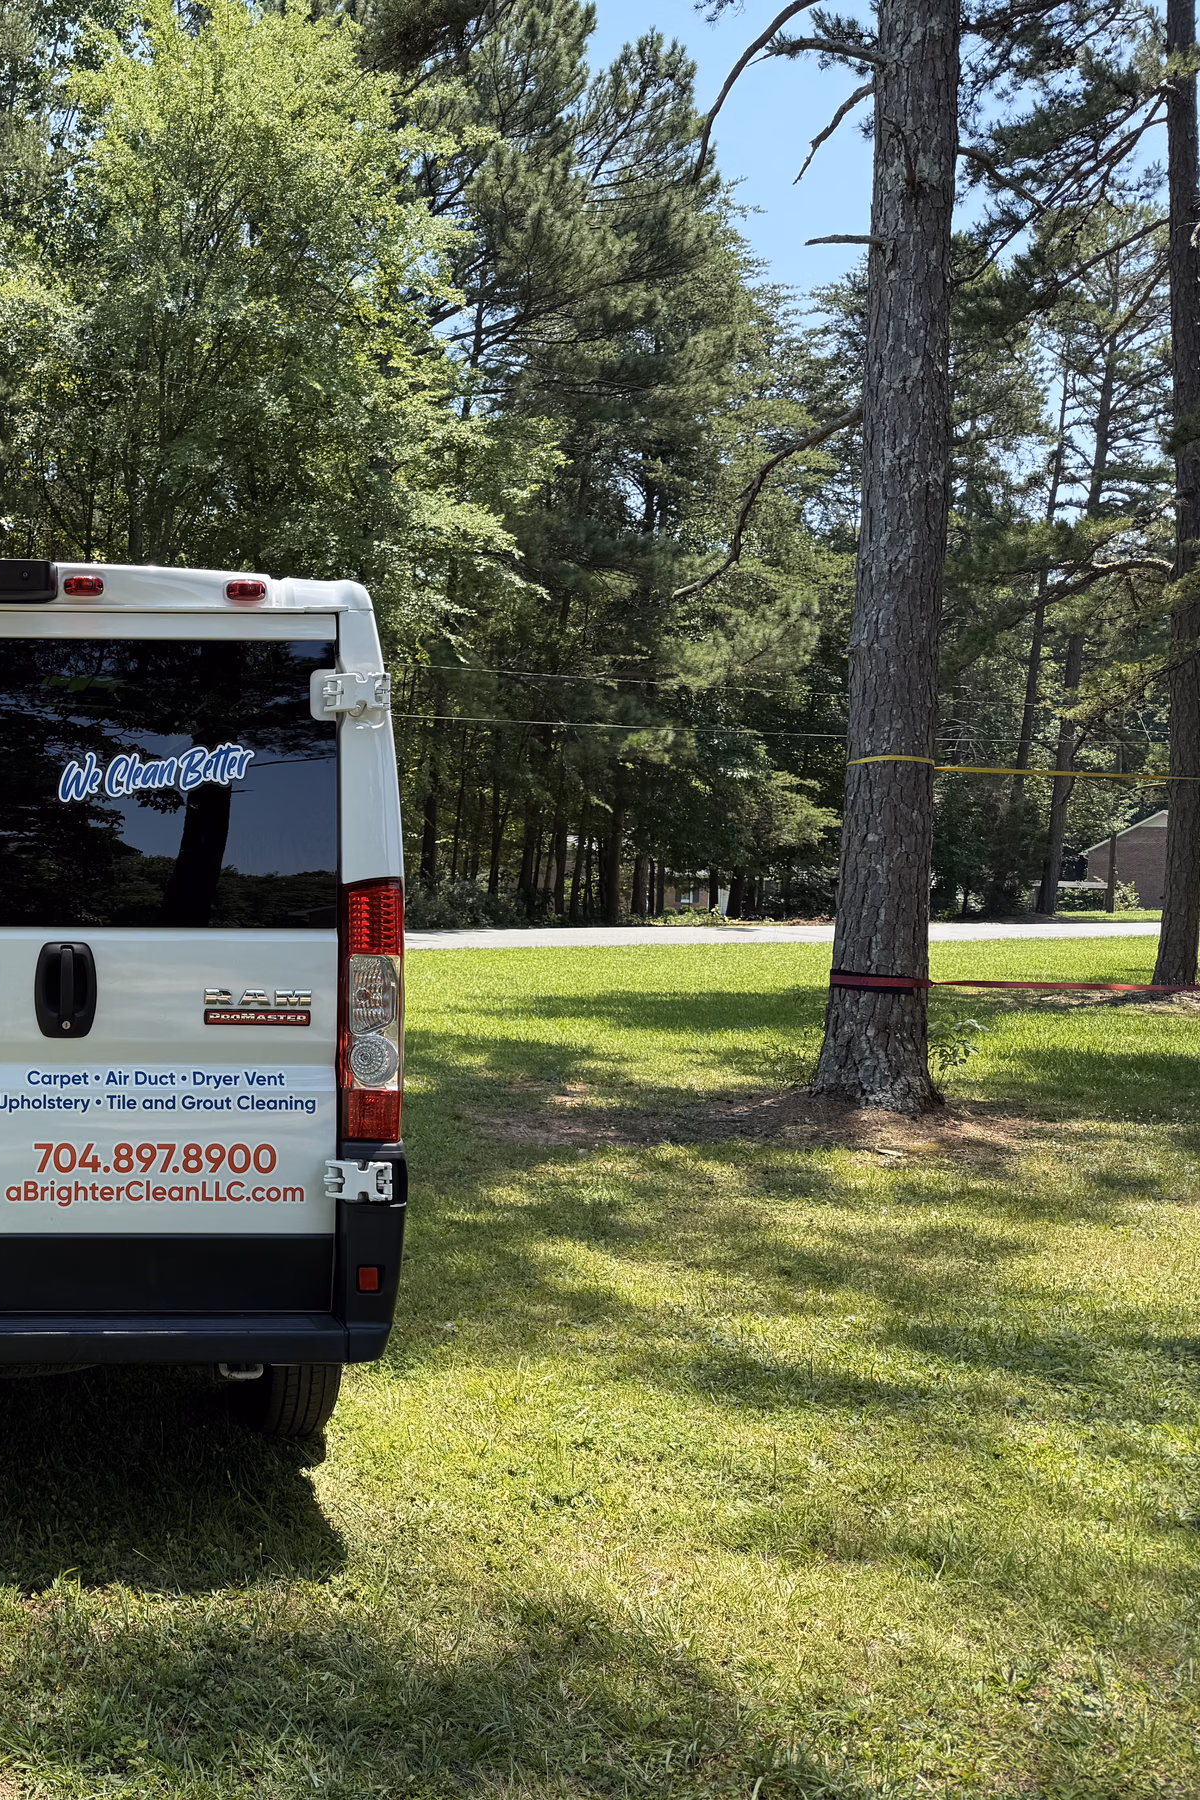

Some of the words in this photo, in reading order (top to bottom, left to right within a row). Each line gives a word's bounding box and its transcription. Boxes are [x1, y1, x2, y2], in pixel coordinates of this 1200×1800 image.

[58, 752, 103, 803] We
[105, 752, 177, 798] Clean
[178, 742, 255, 791] Better
[204, 988, 312, 1006] RAM
[27, 1070, 89, 1089] Carpet
[105, 1071, 129, 1085] Air
[134, 1071, 176, 1086] Duct
[192, 1071, 240, 1089] Dryer
[244, 1071, 285, 1086] Vent
[106, 1094, 137, 1109] Tile
[142, 1095, 176, 1110] and
[181, 1095, 232, 1110] Grout
[237, 1095, 316, 1114] Cleaning
[33, 1143, 277, 1174] 704.897.8900
[5, 1181, 305, 1207] aBrighterCleanLLC.com
